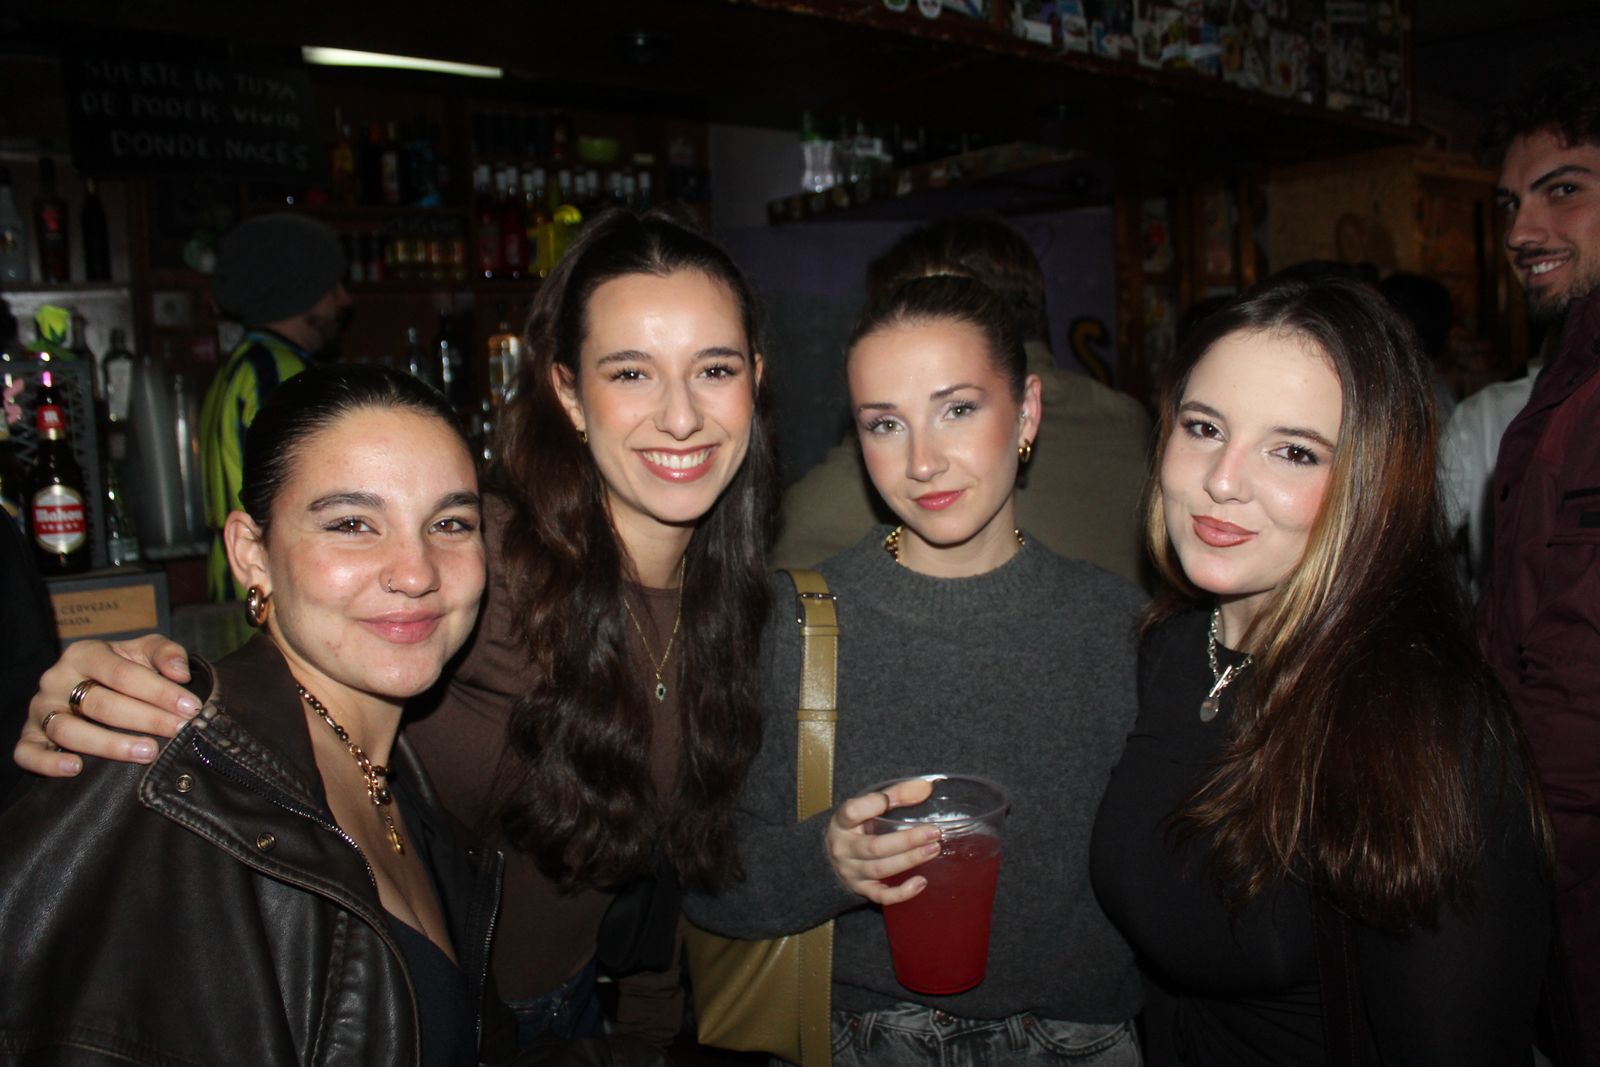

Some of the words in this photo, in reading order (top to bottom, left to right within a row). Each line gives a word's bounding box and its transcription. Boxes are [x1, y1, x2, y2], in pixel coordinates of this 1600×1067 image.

[82, 57, 183, 89] SUERTE
[193, 69, 223, 92] LA
[233, 72, 297, 103] TUYA
[80, 90, 117, 116] DE
[131, 94, 220, 123] PODER
[110, 129, 211, 159] DONDE
[224, 138, 310, 171] NACES
